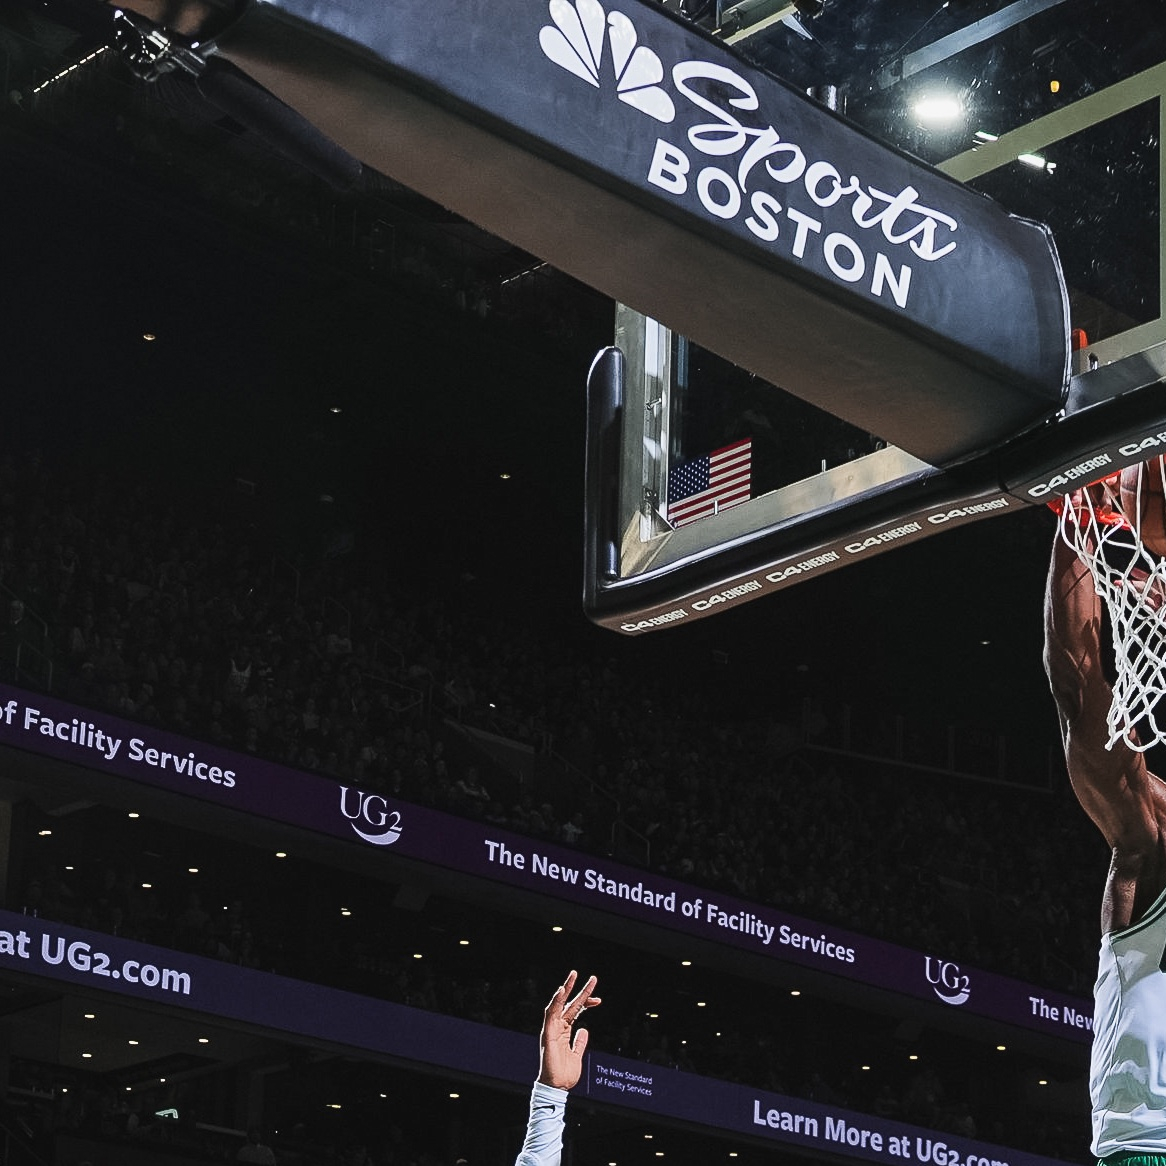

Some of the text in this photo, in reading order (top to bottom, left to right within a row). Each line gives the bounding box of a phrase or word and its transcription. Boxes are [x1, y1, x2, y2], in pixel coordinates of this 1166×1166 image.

[673, 61, 957, 261] Sports
[648, 139, 912, 309] BOSTON
[1064, 454, 1112, 480] ENERGY
[650, 608, 689, 626] ENERGY
[721, 580, 763, 600] ENERGY
[796, 550, 840, 571] ENERGY
[877, 521, 923, 542] ENERGY
[962, 497, 1010, 515] ENERGY
[0, 701, 236, 788] f Facility Services
[339, 786, 403, 832] UG2
[485, 840, 855, 963] The New Standard of Facility Services
[0, 931, 191, 995] at UG2.com
[924, 957, 970, 989] UG2
[1029, 996, 1059, 1021] The
[754, 1100, 819, 1138] Learn
[826, 1117, 883, 1152] More
[889, 1136, 911, 1159] at
